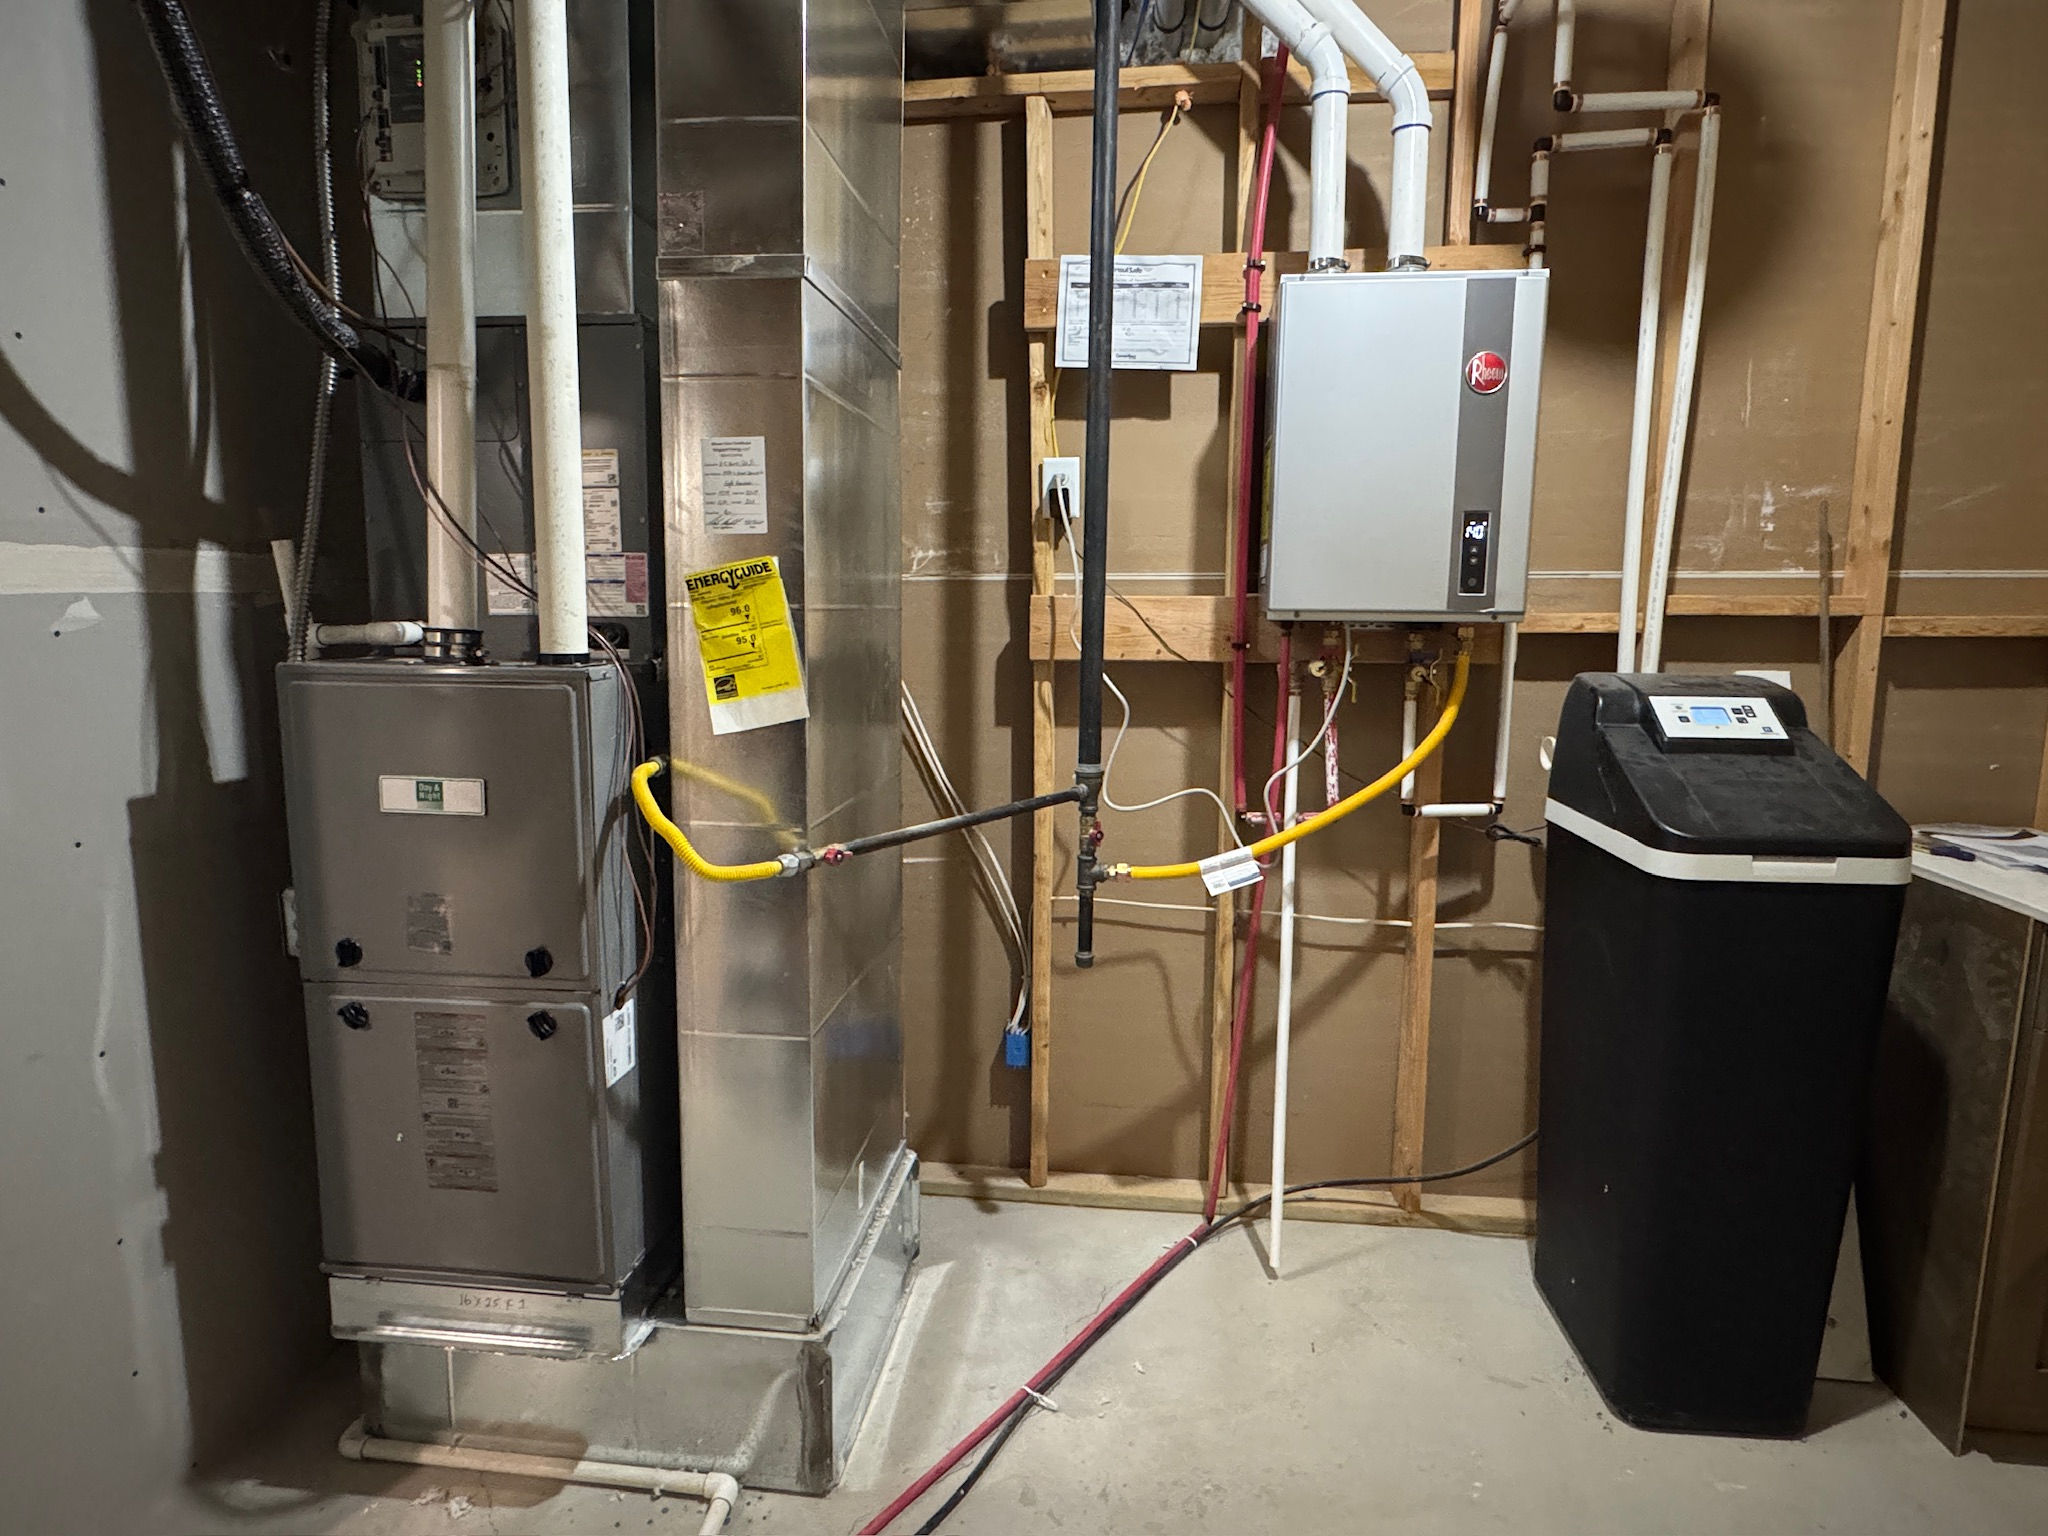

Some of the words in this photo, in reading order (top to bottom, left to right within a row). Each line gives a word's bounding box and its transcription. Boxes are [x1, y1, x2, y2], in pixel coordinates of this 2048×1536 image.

[1471, 355, 1504, 386] Rheem
[685, 562, 772, 591] ENERGYGUIDE
[418, 783, 433, 793] Day
[419, 791, 441, 802] Night
